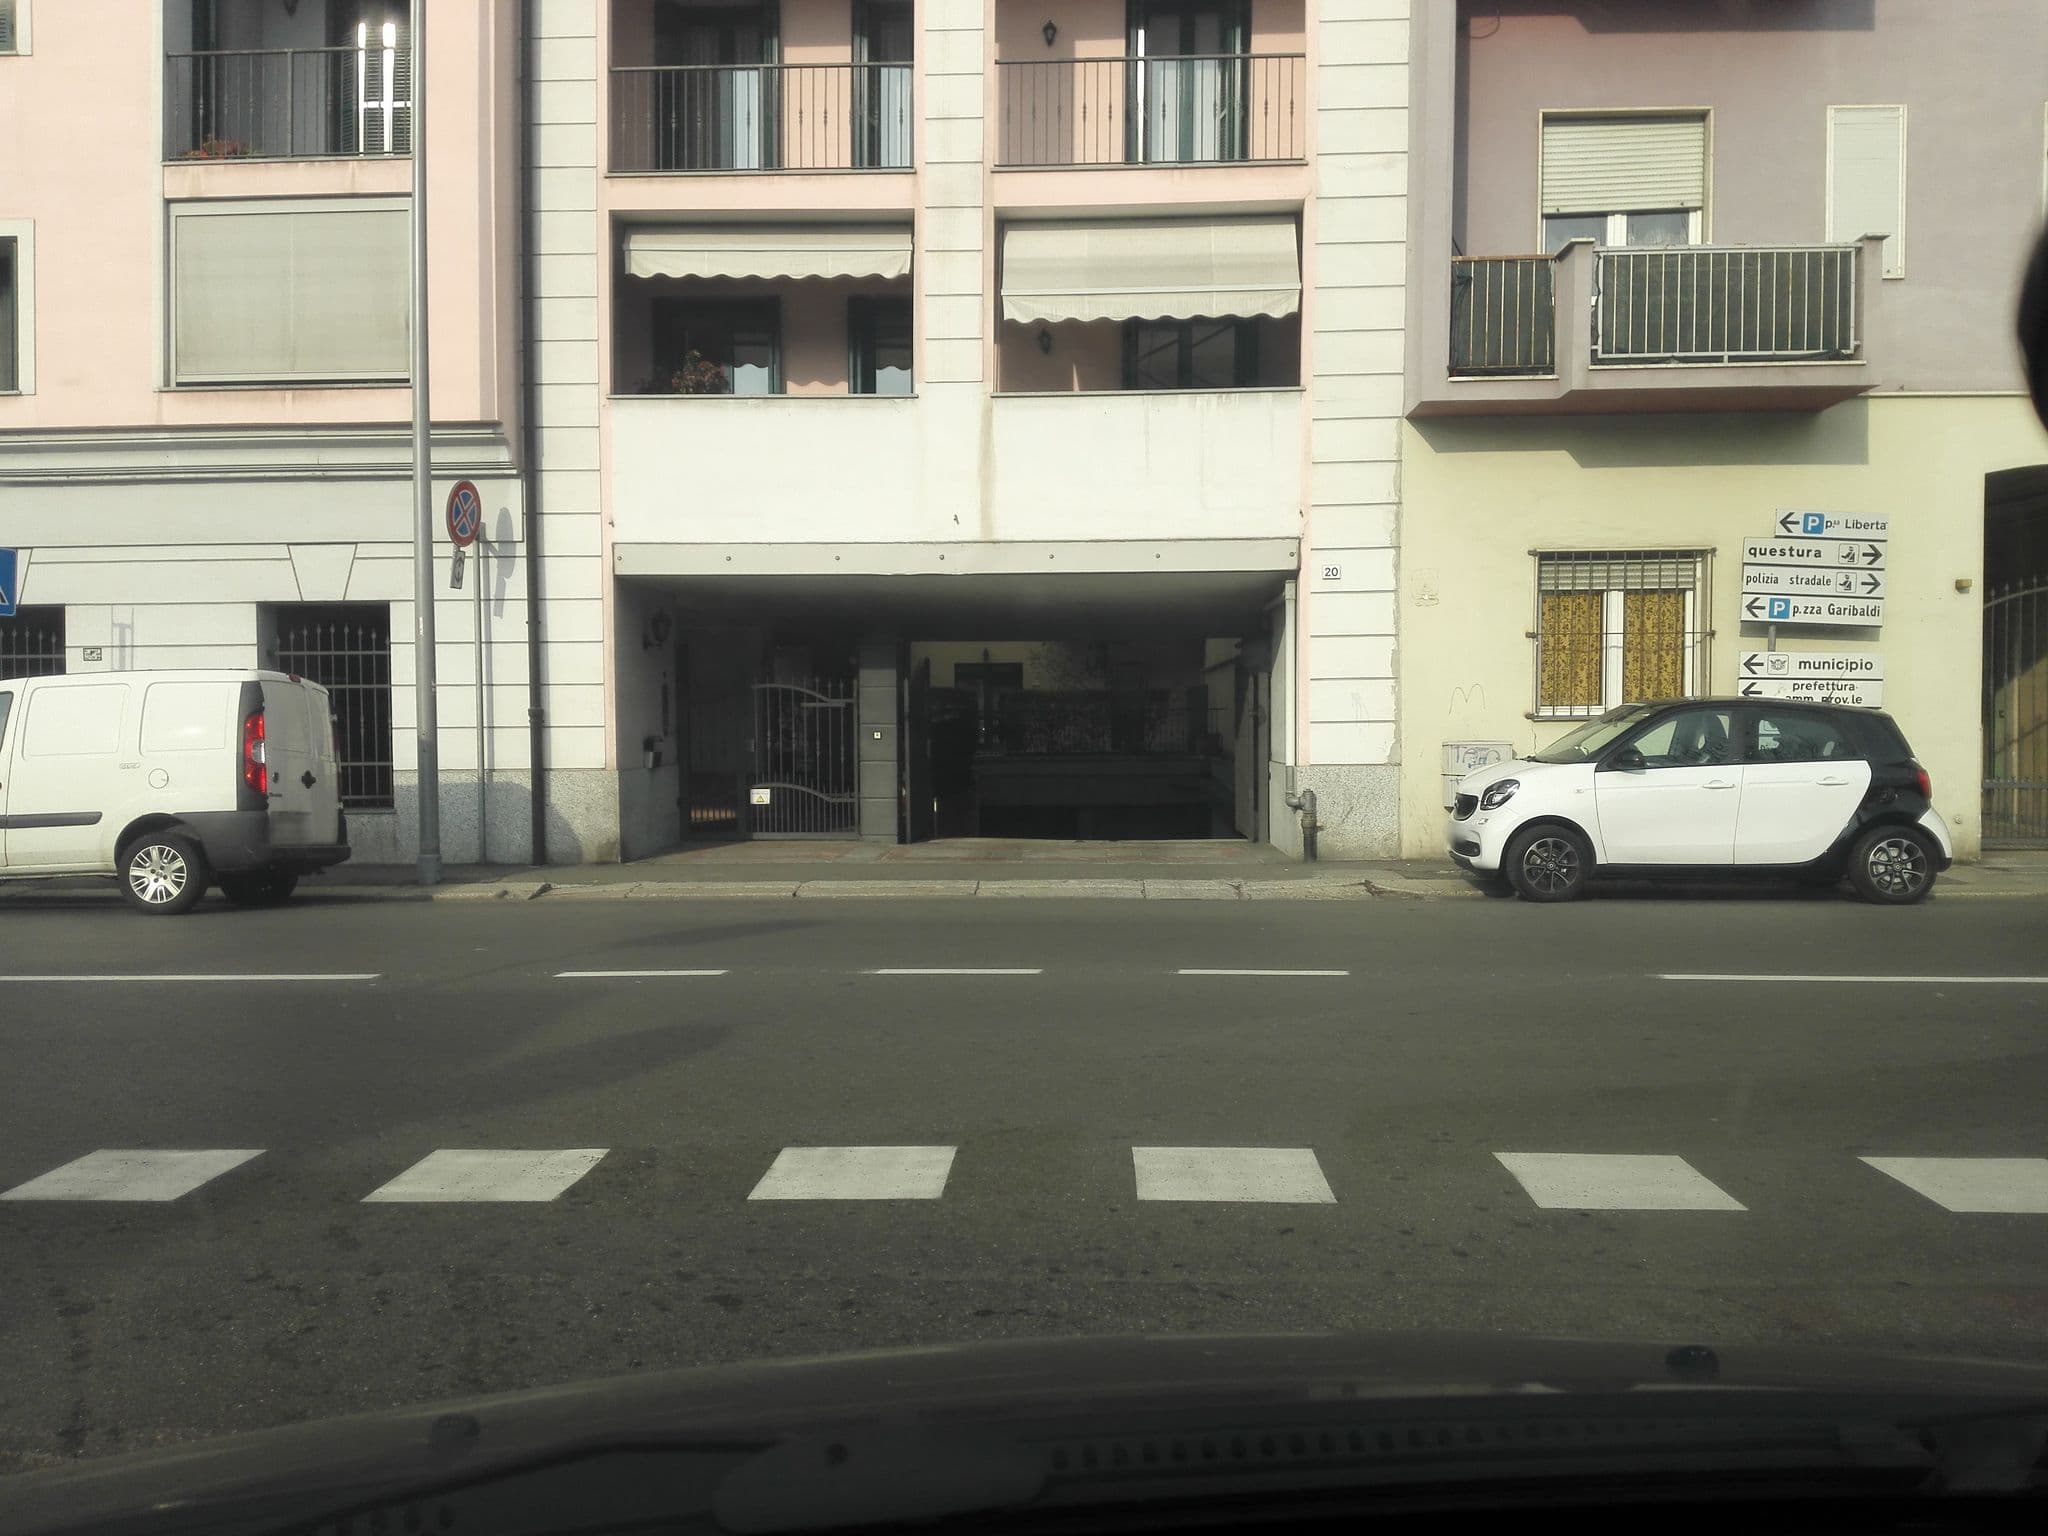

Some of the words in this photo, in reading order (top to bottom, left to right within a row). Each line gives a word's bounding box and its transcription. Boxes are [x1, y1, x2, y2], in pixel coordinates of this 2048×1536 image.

[1748, 545, 1822, 558] questura
[1324, 566, 1339, 577] 20
[1745, 573, 1779, 585] polizia
[1789, 574, 1832, 586] stradale
[1792, 605, 1822, 616] p.zza
[1827, 603, 1881, 617] Garibaldi
[1798, 658, 1874, 672] municipio
